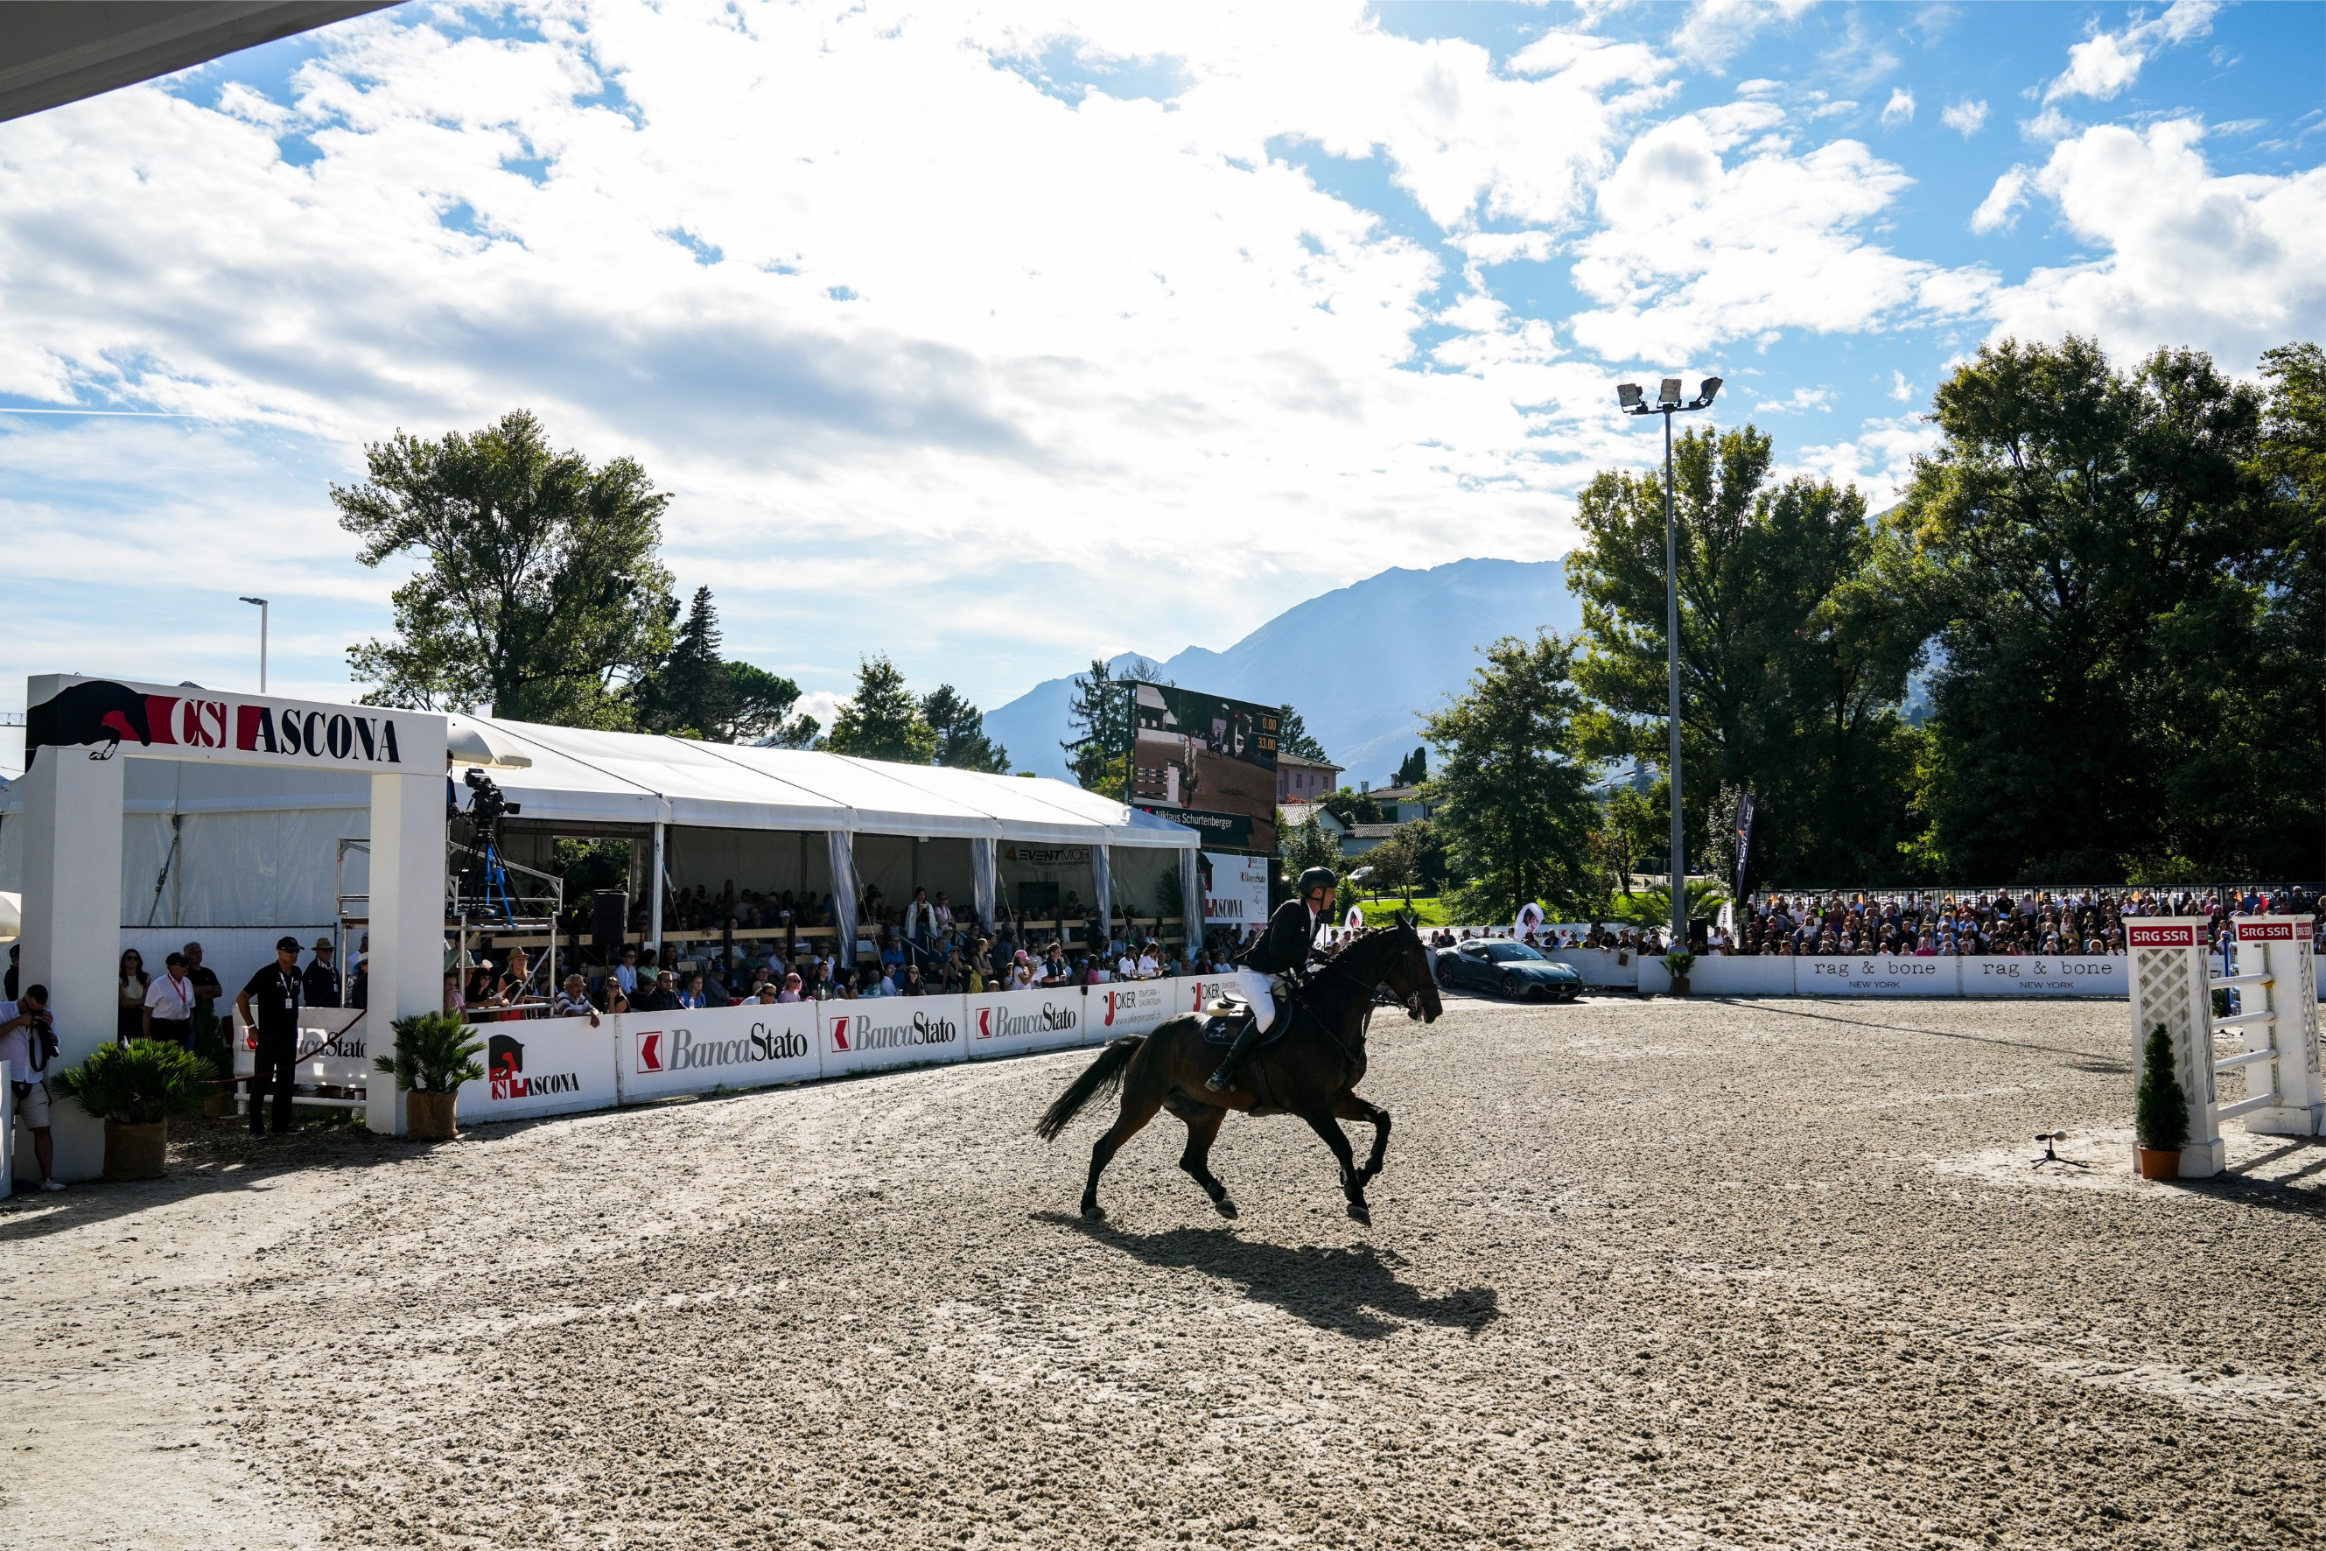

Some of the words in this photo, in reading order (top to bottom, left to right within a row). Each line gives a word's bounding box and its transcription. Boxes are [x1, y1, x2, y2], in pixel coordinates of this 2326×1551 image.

[1262, 717, 1277, 731] 0.00
[253, 707, 402, 763] ASCONA
[1257, 736, 1276, 751] 33.00
[1155, 810, 1181, 823] Niklaus
[1182, 812, 1233, 830] Schurtenberger
[1019, 848, 1090, 861] EVENTMOR
[1213, 898, 1244, 918] ASCONA
[2133, 931, 2160, 942] SRG
[2162, 930, 2190, 942] SSR
[2241, 927, 2265, 937] SRG
[2267, 926, 2290, 936] SSR
[1814, 962, 1850, 978] rag
[1861, 960, 1875, 975] &
[1887, 960, 1936, 975] bone
[1982, 962, 2020, 978] rag
[2032, 960, 2047, 975] &
[2061, 960, 2113, 976] bone
[1849, 981, 1872, 989] NEW
[1873, 981, 1900, 989] YORK
[2019, 981, 2044, 989] NEW
[2044, 981, 2074, 989] YORK
[1104, 990, 1136, 1027] JOKER
[994, 1001, 1076, 1038] BancaStato
[853, 1011, 956, 1051] BancaStato
[668, 1022, 808, 1071] BancaStato
[525, 1072, 580, 1097] ASCONA
